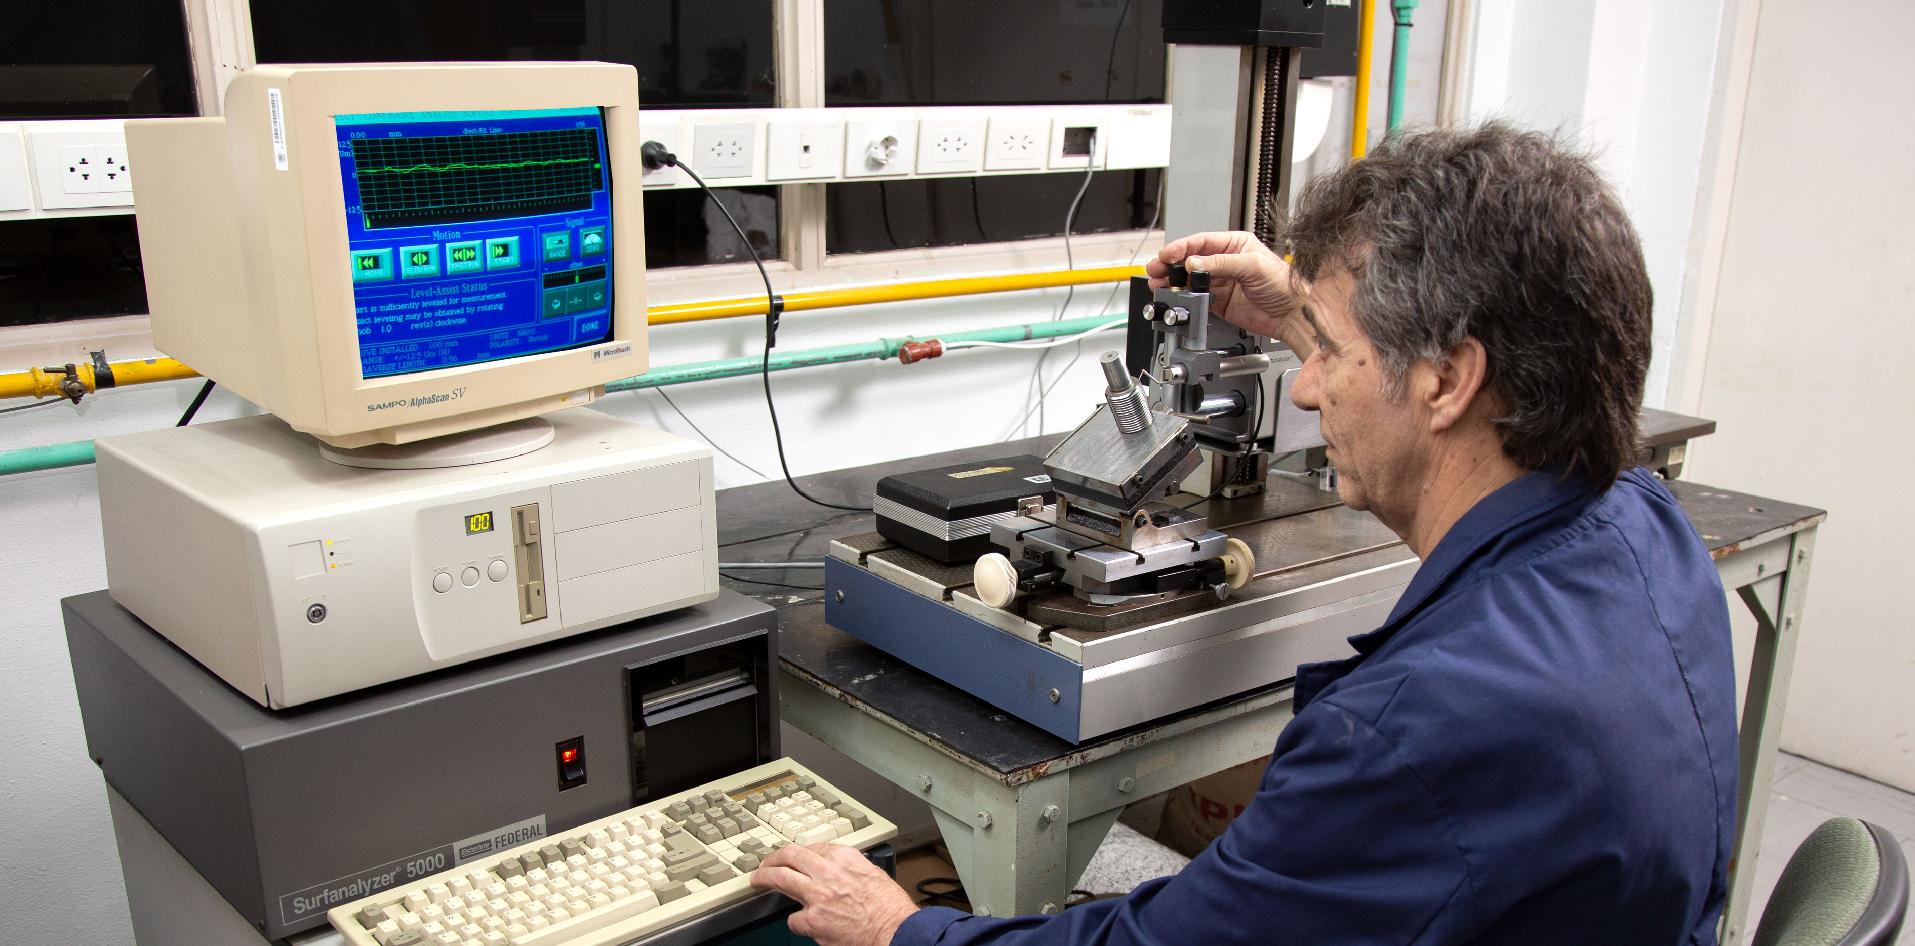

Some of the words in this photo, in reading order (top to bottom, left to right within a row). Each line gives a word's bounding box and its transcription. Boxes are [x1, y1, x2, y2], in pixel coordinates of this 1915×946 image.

[432, 230, 461, 241] Motion
[411, 285, 459, 299] Level-Assist
[462, 282, 488, 293] Status
[380, 301, 420, 312] sufficiently
[422, 297, 448, 308] leveled
[449, 297, 459, 305] for
[374, 314, 404, 323] leveling
[405, 312, 421, 320] may
[435, 307, 464, 316] obtained
[466, 306, 475, 314] by
[477, 302, 504, 312] rotating
[381, 324, 392, 333] 1.0
[411, 320, 433, 330] rev(s)
[435, 317, 466, 327] clockwise
[581, 320, 599, 333] DONE
[379, 344, 418, 355] INSTALLED
[603, 345, 630, 357] MicroTouch
[398, 359, 425, 369] LENGTH
[450, 386, 467, 400] SV
[470, 513, 490, 531] 100
[494, 823, 543, 850] FEDERAL
[406, 853, 445, 878] 5000
